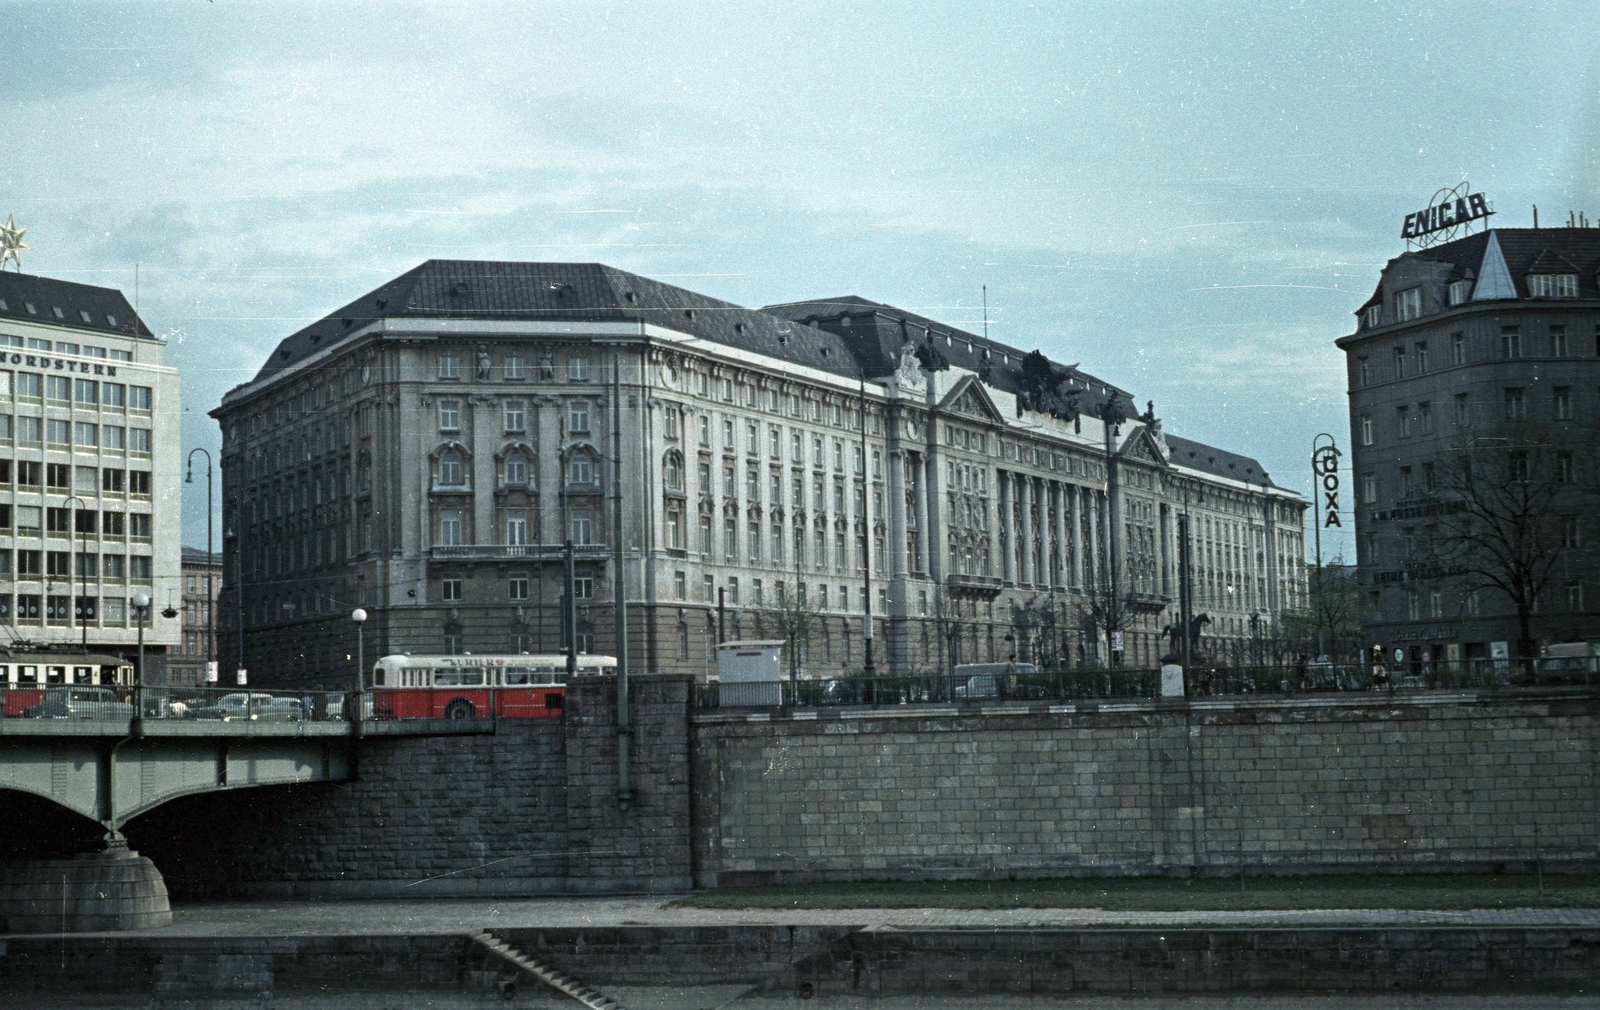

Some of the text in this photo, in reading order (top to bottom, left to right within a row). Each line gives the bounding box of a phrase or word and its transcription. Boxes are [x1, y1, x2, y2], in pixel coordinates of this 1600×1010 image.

[1401, 193, 1488, 238] ENICAR
[0, 351, 116, 376] NORDSTERN
[1323, 456, 1342, 528] DOXA
